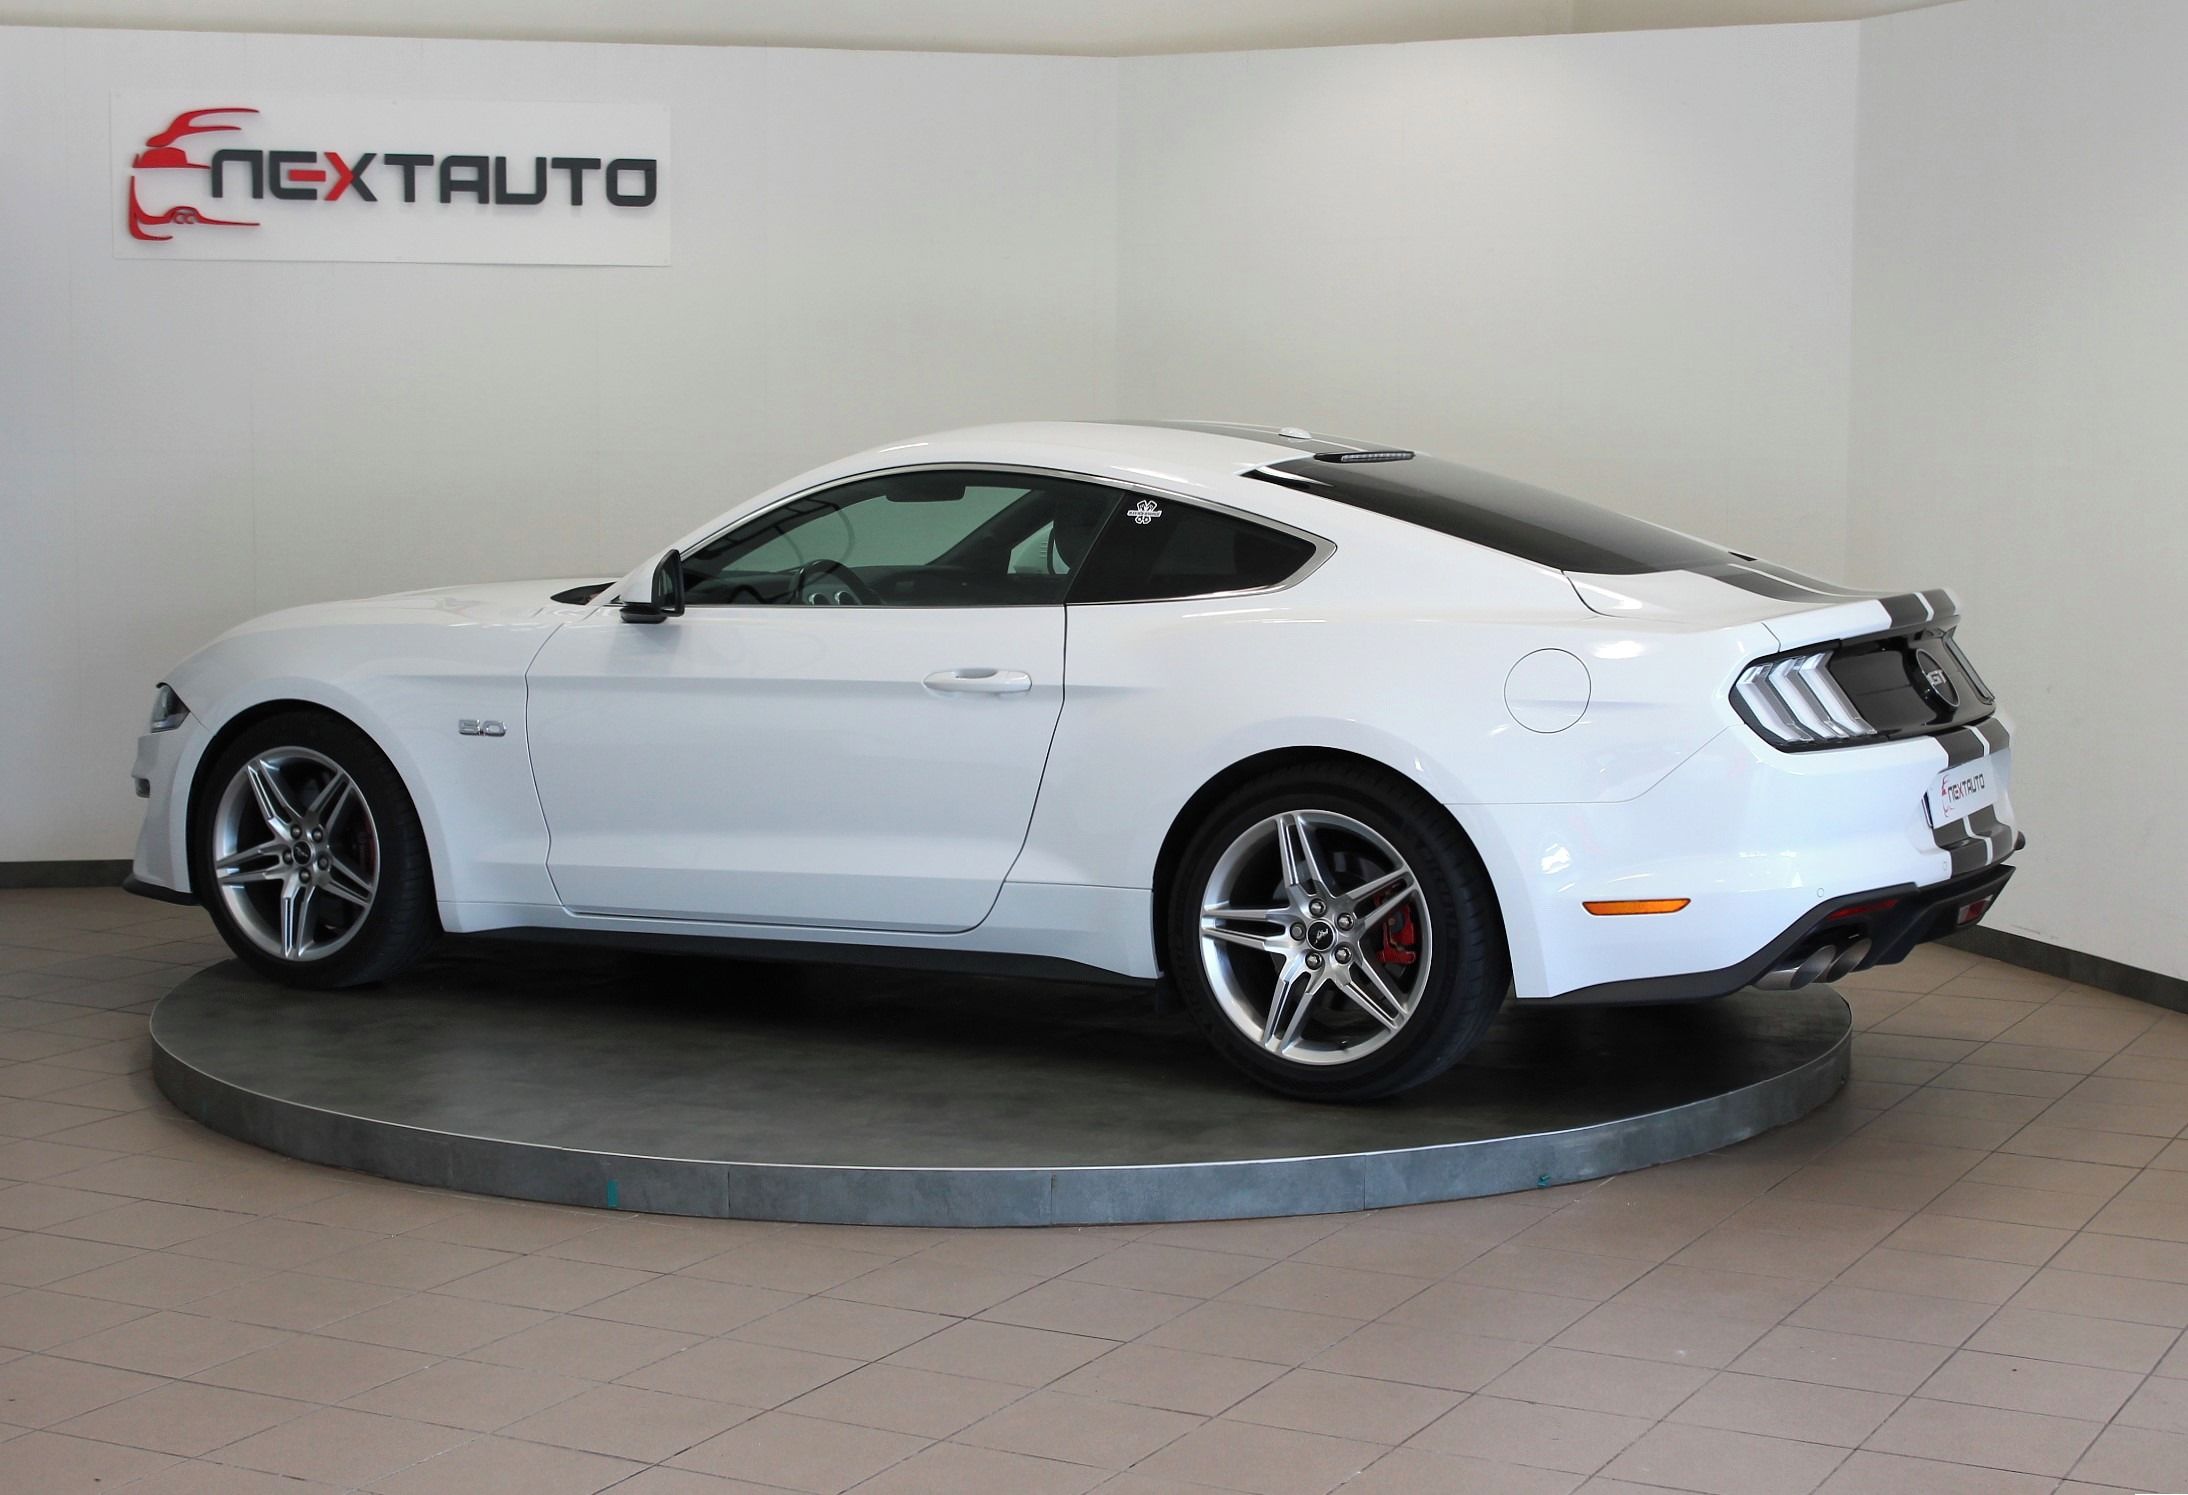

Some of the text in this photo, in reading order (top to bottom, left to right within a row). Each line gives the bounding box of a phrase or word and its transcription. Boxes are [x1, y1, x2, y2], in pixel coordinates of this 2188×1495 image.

[211, 149, 657, 207] NEXTAUTO
[1926, 669, 1947, 686] GT
[458, 719, 506, 737] 5.0
[1947, 773, 1985, 802] NEXTAUTO
